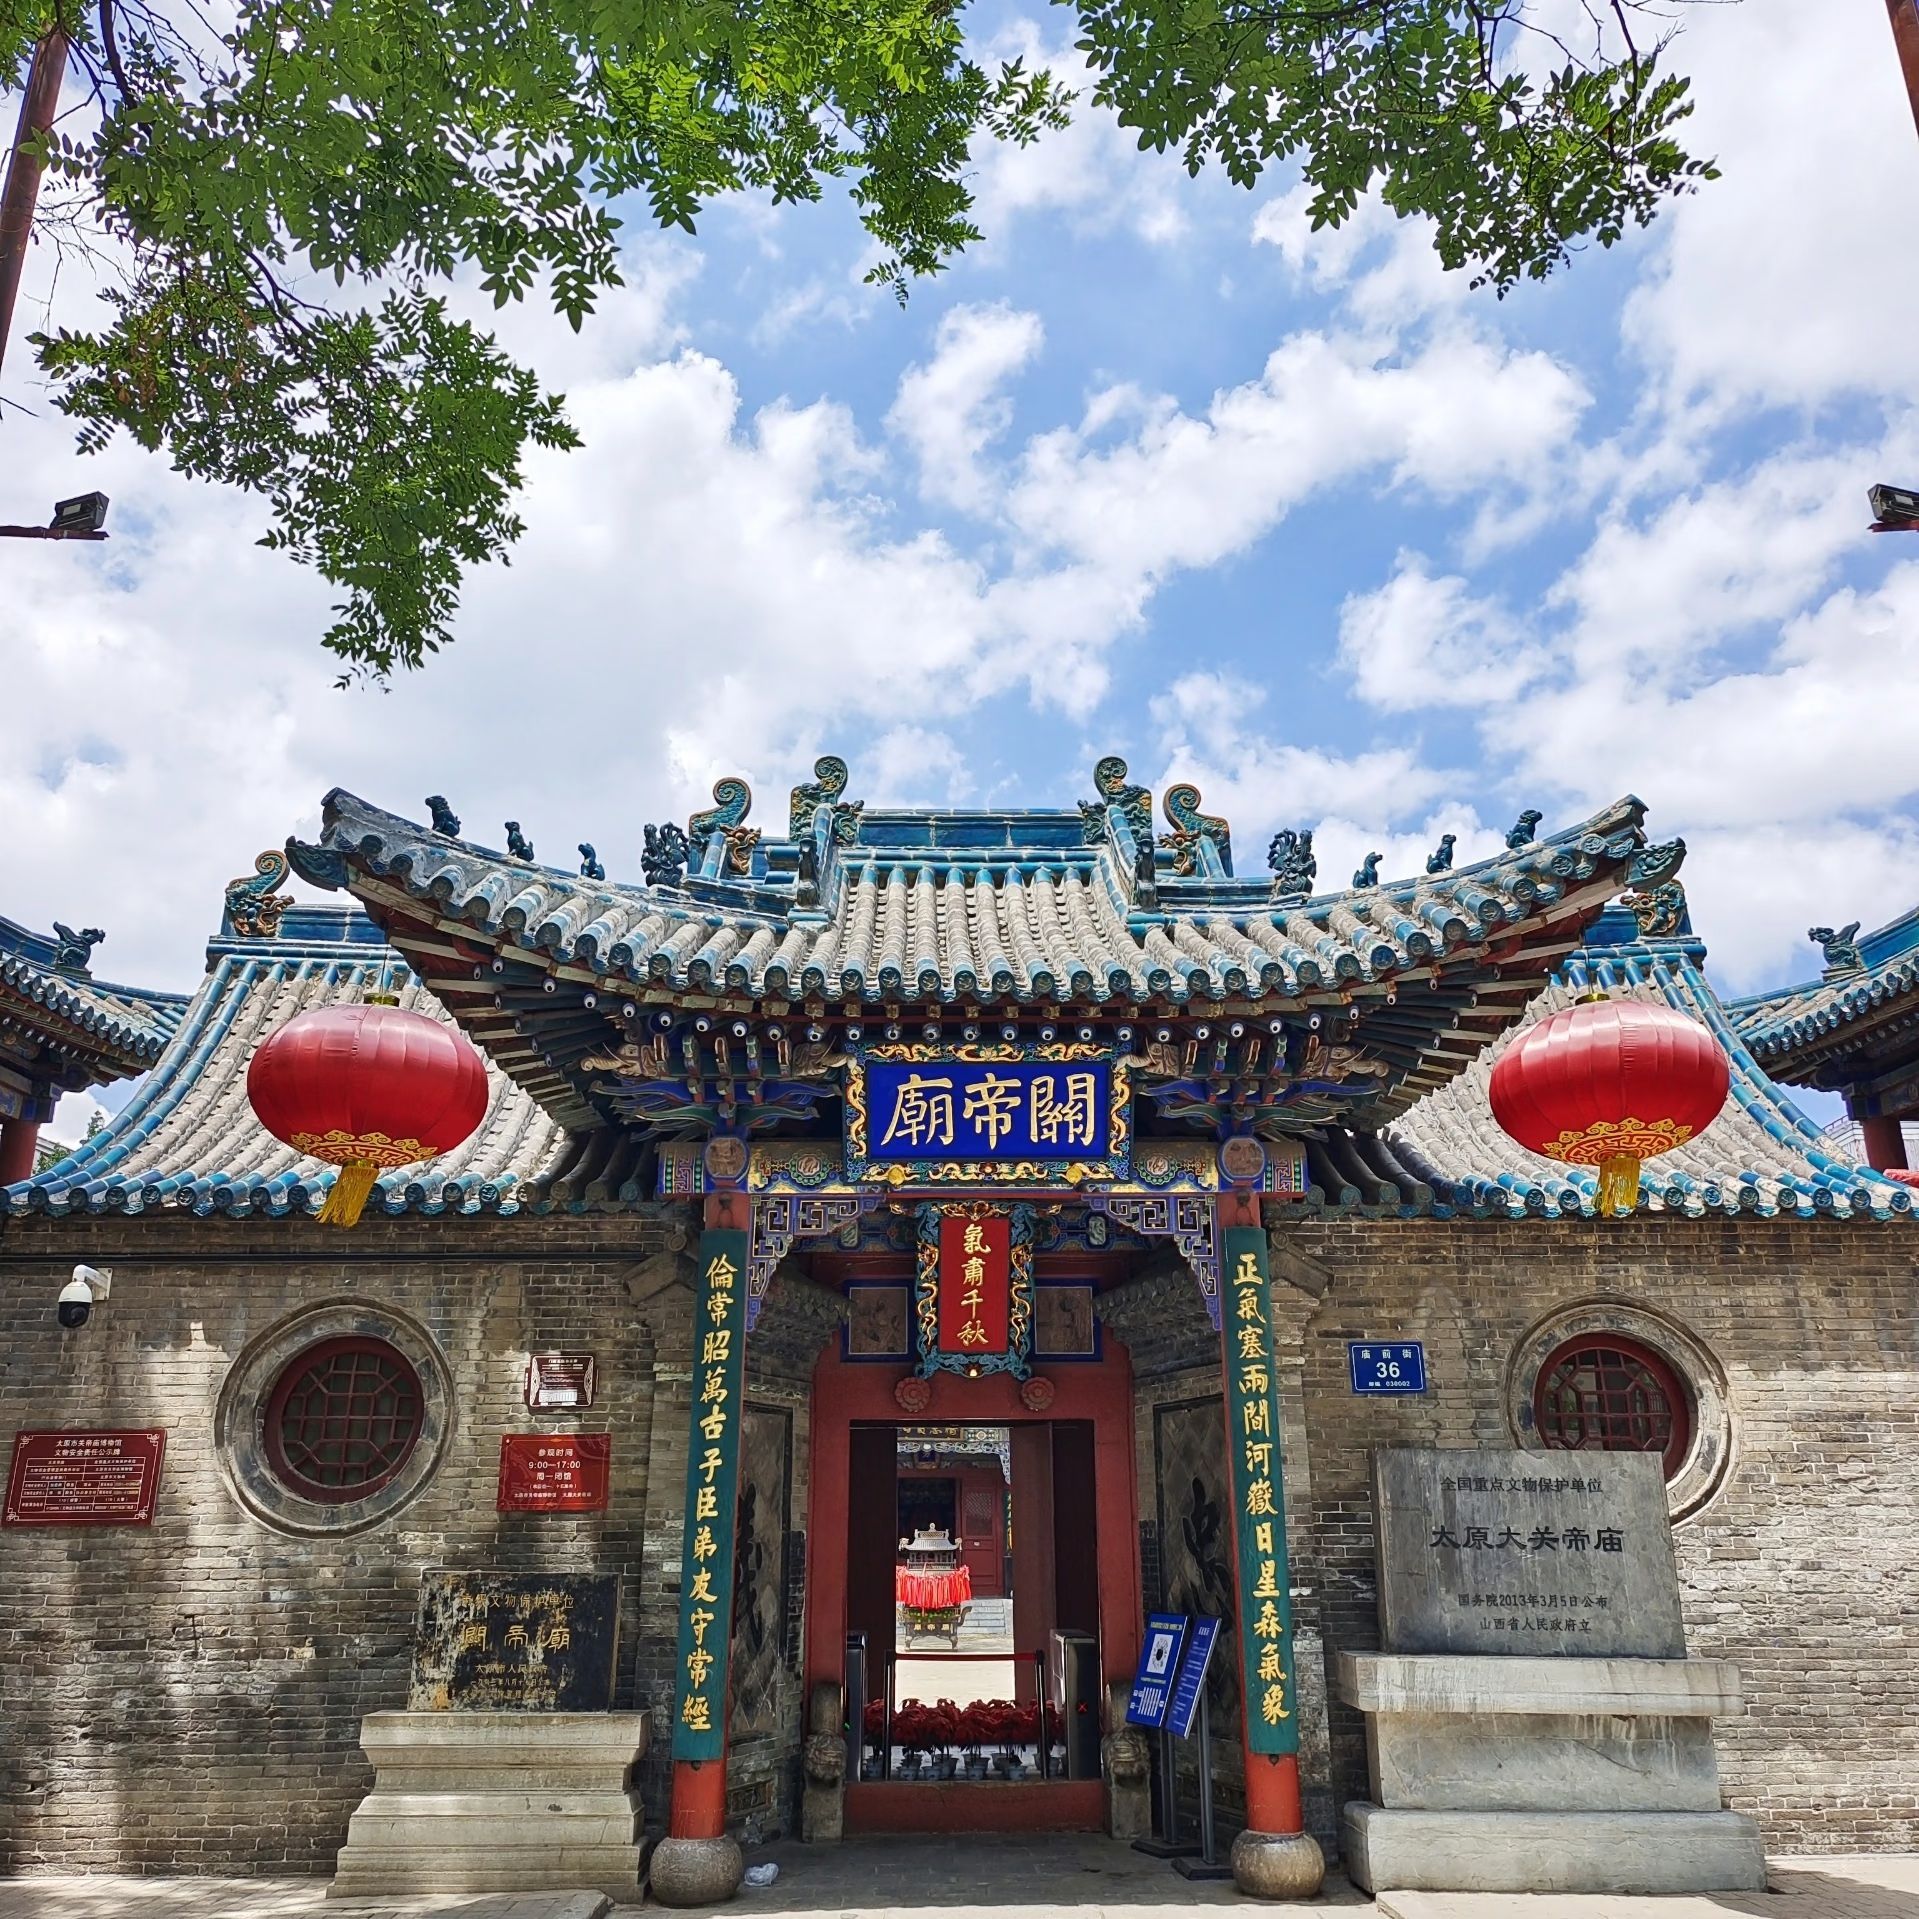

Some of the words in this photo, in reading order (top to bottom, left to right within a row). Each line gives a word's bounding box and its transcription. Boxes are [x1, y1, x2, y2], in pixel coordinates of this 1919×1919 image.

[1376, 1361, 1400, 1378] 36
[538, 1448, 574, 1457] 参观时间
[1440, 1476, 1603, 1493] 全国重点文物保护单位
[1429, 1525, 1625, 1553] 太原大关帝庙
[1458, 1593, 1608, 1609] 国务院2013年3月5日公布
[1480, 1617, 1592, 1632] 山西省人民政府立
